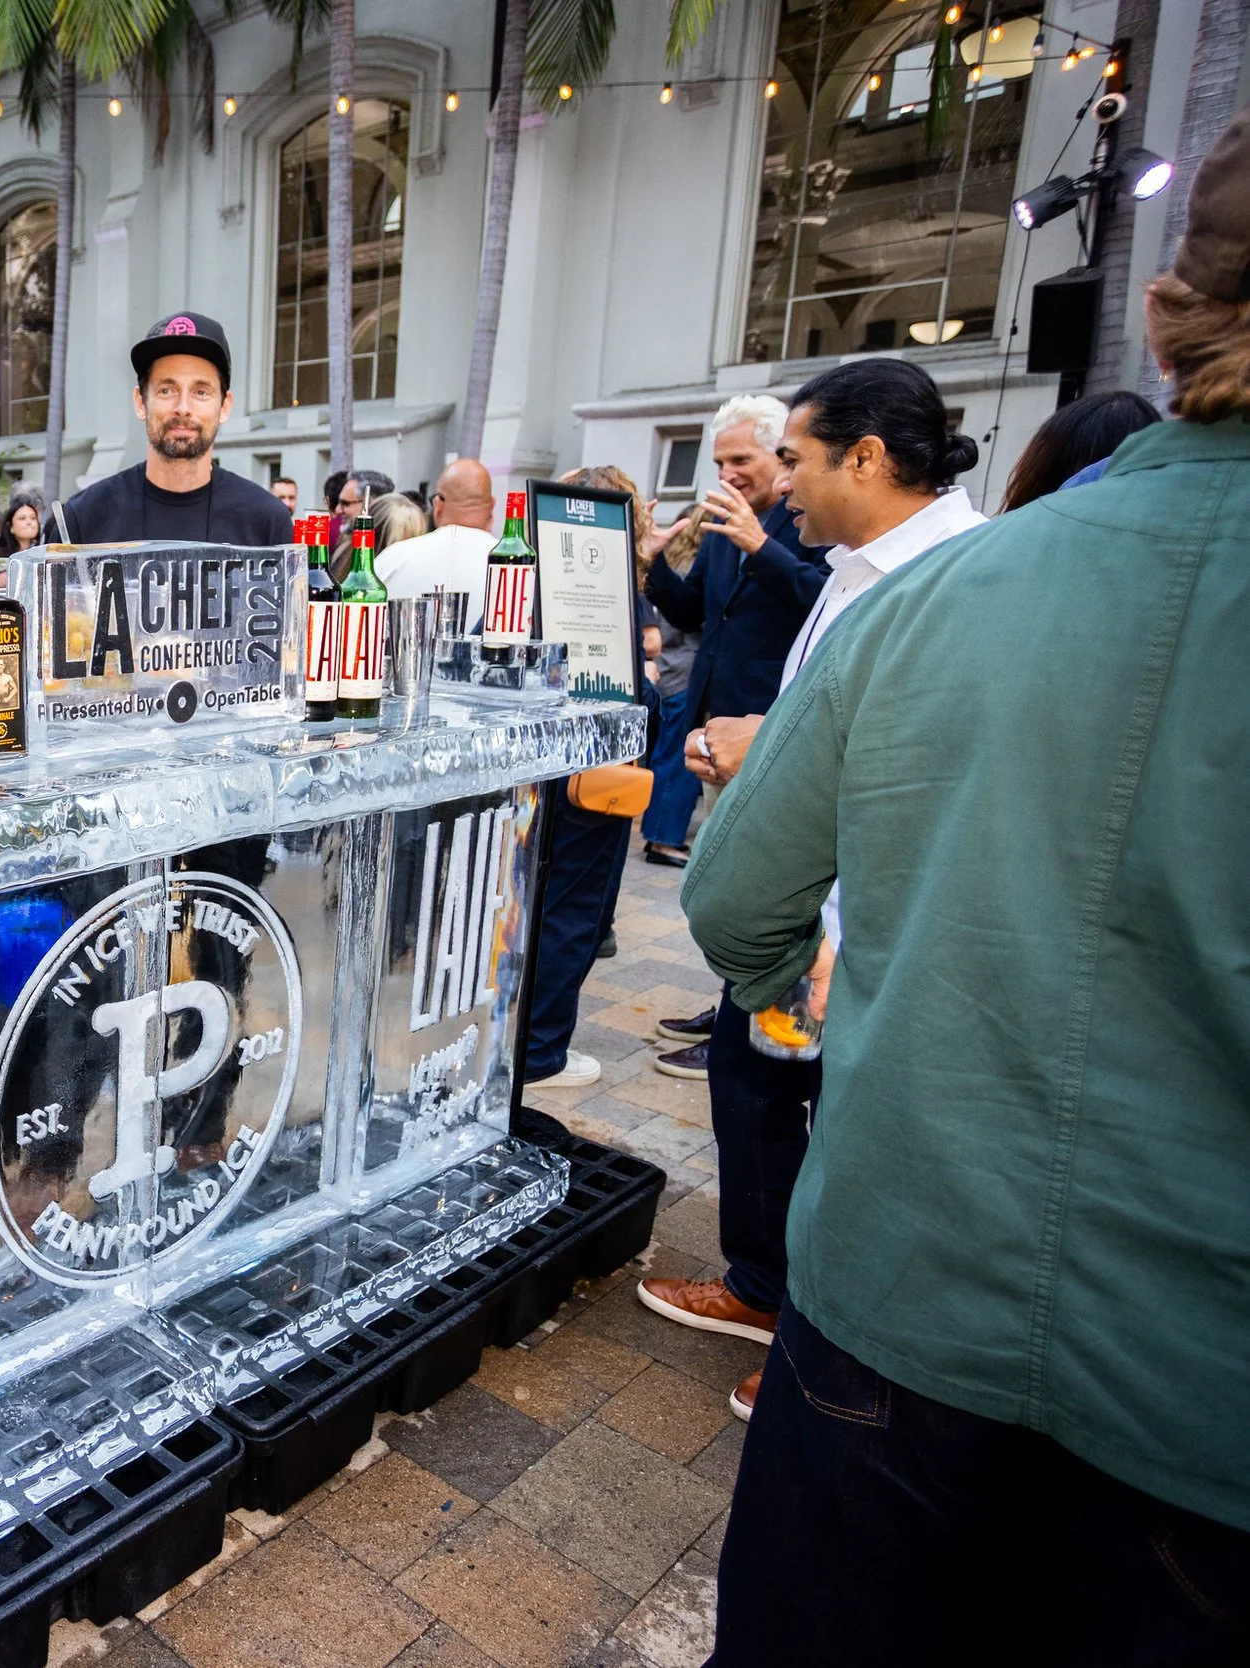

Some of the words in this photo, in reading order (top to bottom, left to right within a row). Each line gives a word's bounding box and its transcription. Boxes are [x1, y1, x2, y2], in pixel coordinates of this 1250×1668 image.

[50, 559, 135, 680] LA
[138, 559, 244, 634] CHEF
[246, 558, 283, 665] 2025
[485, 567, 530, 632] LAIE
[140, 639, 243, 673] CONFERENCE
[52, 693, 133, 722] Presented
[136, 694, 153, 717] by
[204, 685, 281, 711] OpenTable
[51, 961, 91, 1006] IN
[84, 916, 133, 972] ICE
[135, 900, 182, 935] WE
[193, 898, 262, 957] TRUST
[410, 806, 514, 1033] LAIE
[15, 1102, 70, 1147] EST.
[30, 1201, 120, 1262] PENNY
[123, 1177, 221, 1249] POUND
[218, 1123, 263, 1184] ICE
